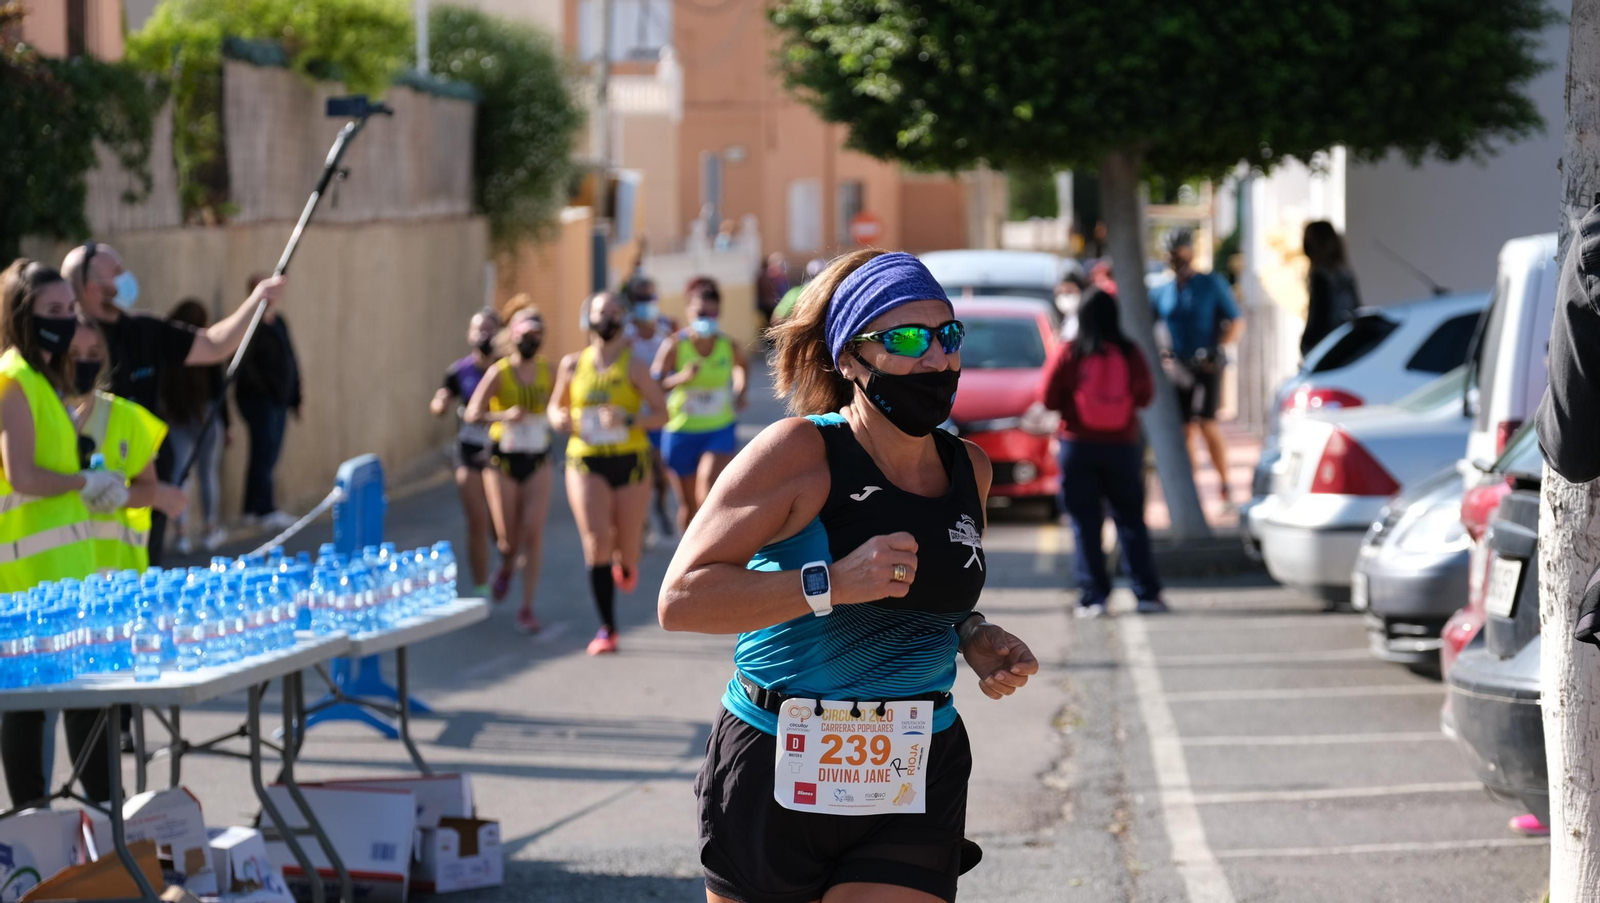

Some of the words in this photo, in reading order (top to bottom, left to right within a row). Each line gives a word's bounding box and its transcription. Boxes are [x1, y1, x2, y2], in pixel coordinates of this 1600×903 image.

[822, 708, 866, 722] CIRCUO
[821, 723, 856, 732] CARRERAS
[857, 723, 894, 733] POPULARES
[792, 737, 799, 749] D
[819, 734, 892, 766] 239
[907, 743, 920, 776] RIOJA
[818, 768, 860, 784] DIVINA
[863, 768, 891, 784] JANE
